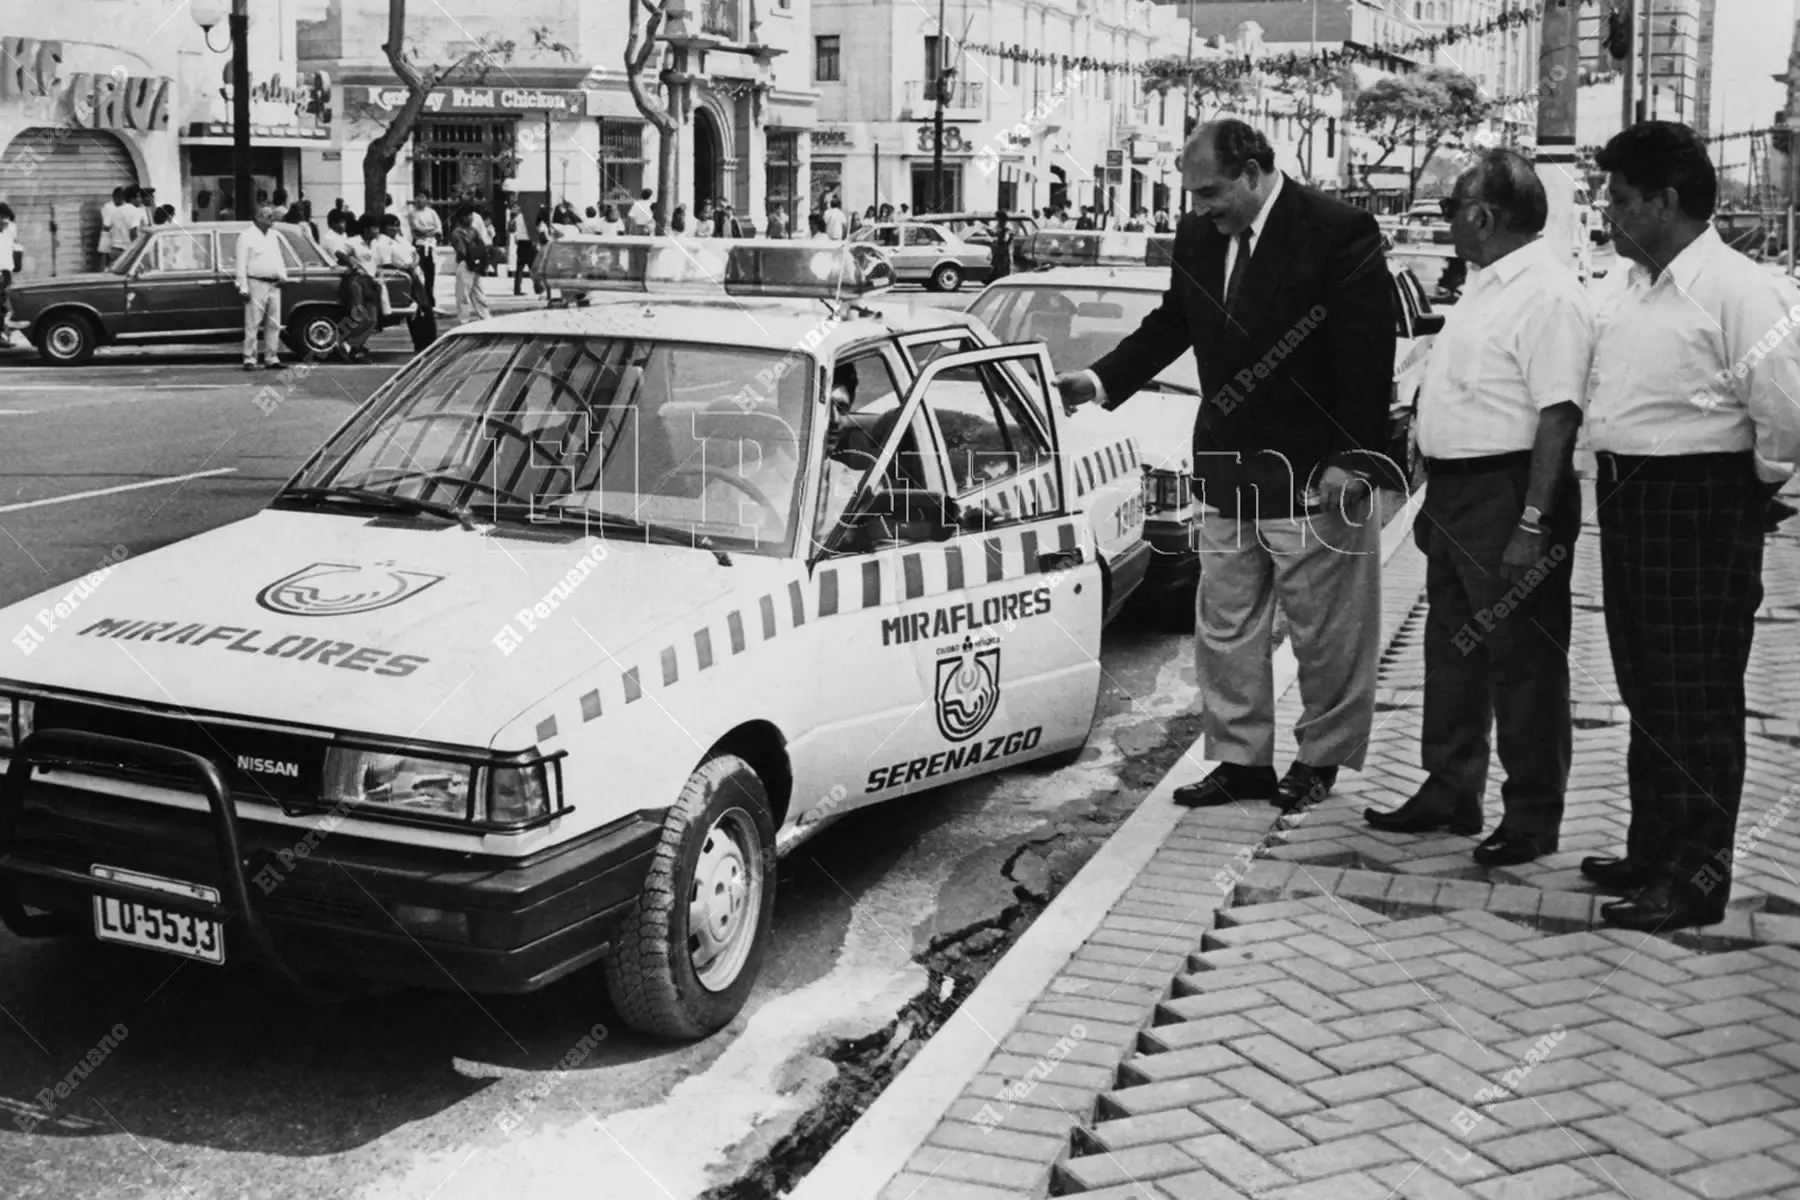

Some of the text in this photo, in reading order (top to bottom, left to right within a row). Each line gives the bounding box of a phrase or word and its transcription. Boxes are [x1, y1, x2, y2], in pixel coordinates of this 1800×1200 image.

[452, 88, 495, 107] Fried
[501, 89, 566, 108] Chicken
[881, 587, 1051, 646] MIRAFLORES
[76, 617, 430, 677] MIRAFLORES
[237, 755, 299, 778] NISSAN
[864, 726, 1043, 794] SERENAZGO
